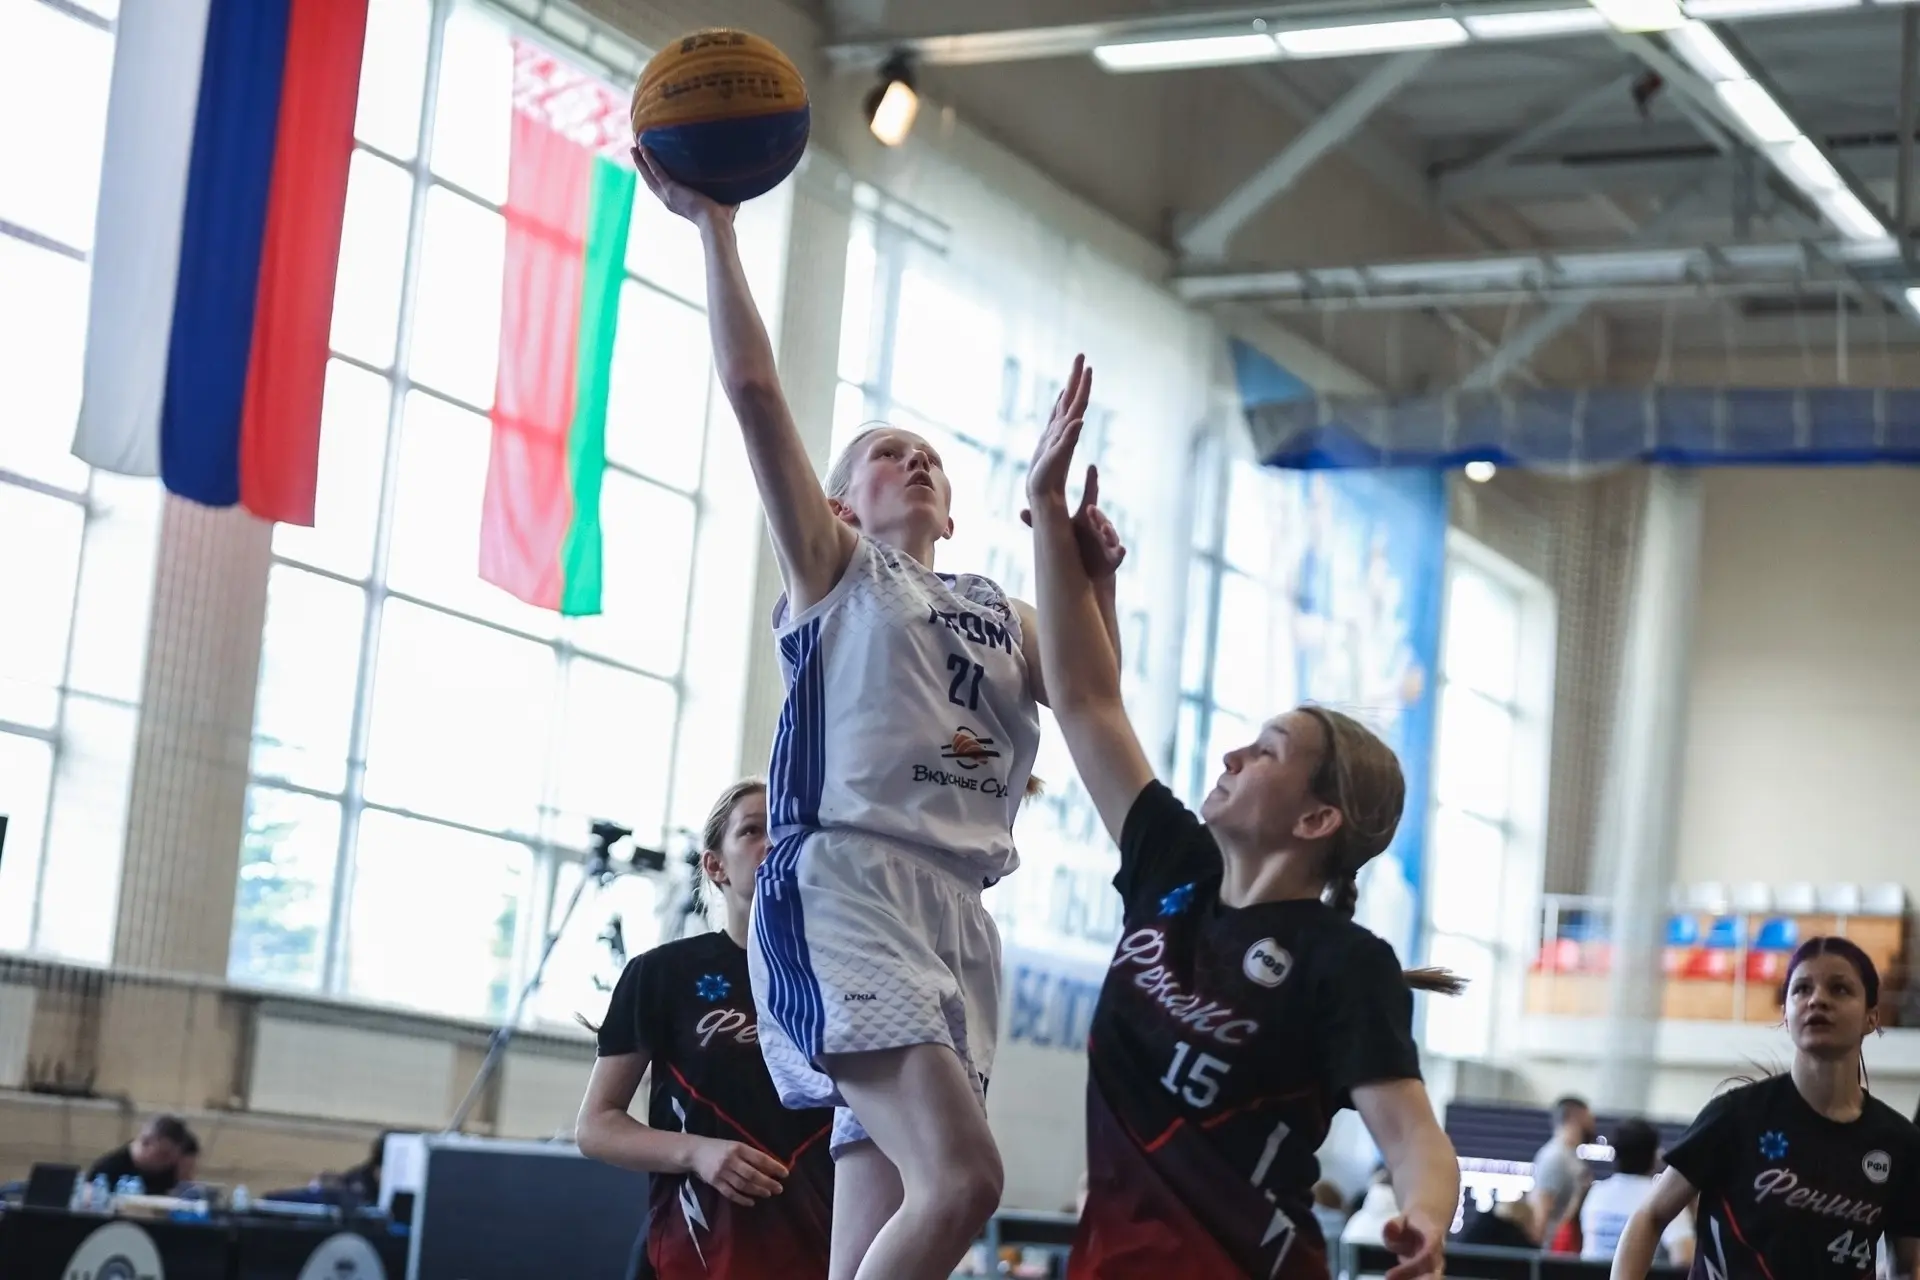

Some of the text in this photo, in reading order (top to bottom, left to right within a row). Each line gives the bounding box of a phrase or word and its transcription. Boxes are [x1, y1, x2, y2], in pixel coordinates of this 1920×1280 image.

[947, 653, 984, 711] 21
[844, 993, 877, 1001] LYKIA
[696, 1008, 759, 1047] Фе
[1160, 1041, 1232, 1108] 15
[1753, 1168, 1882, 1224] Феникс
[1827, 1229, 1871, 1269] 44
